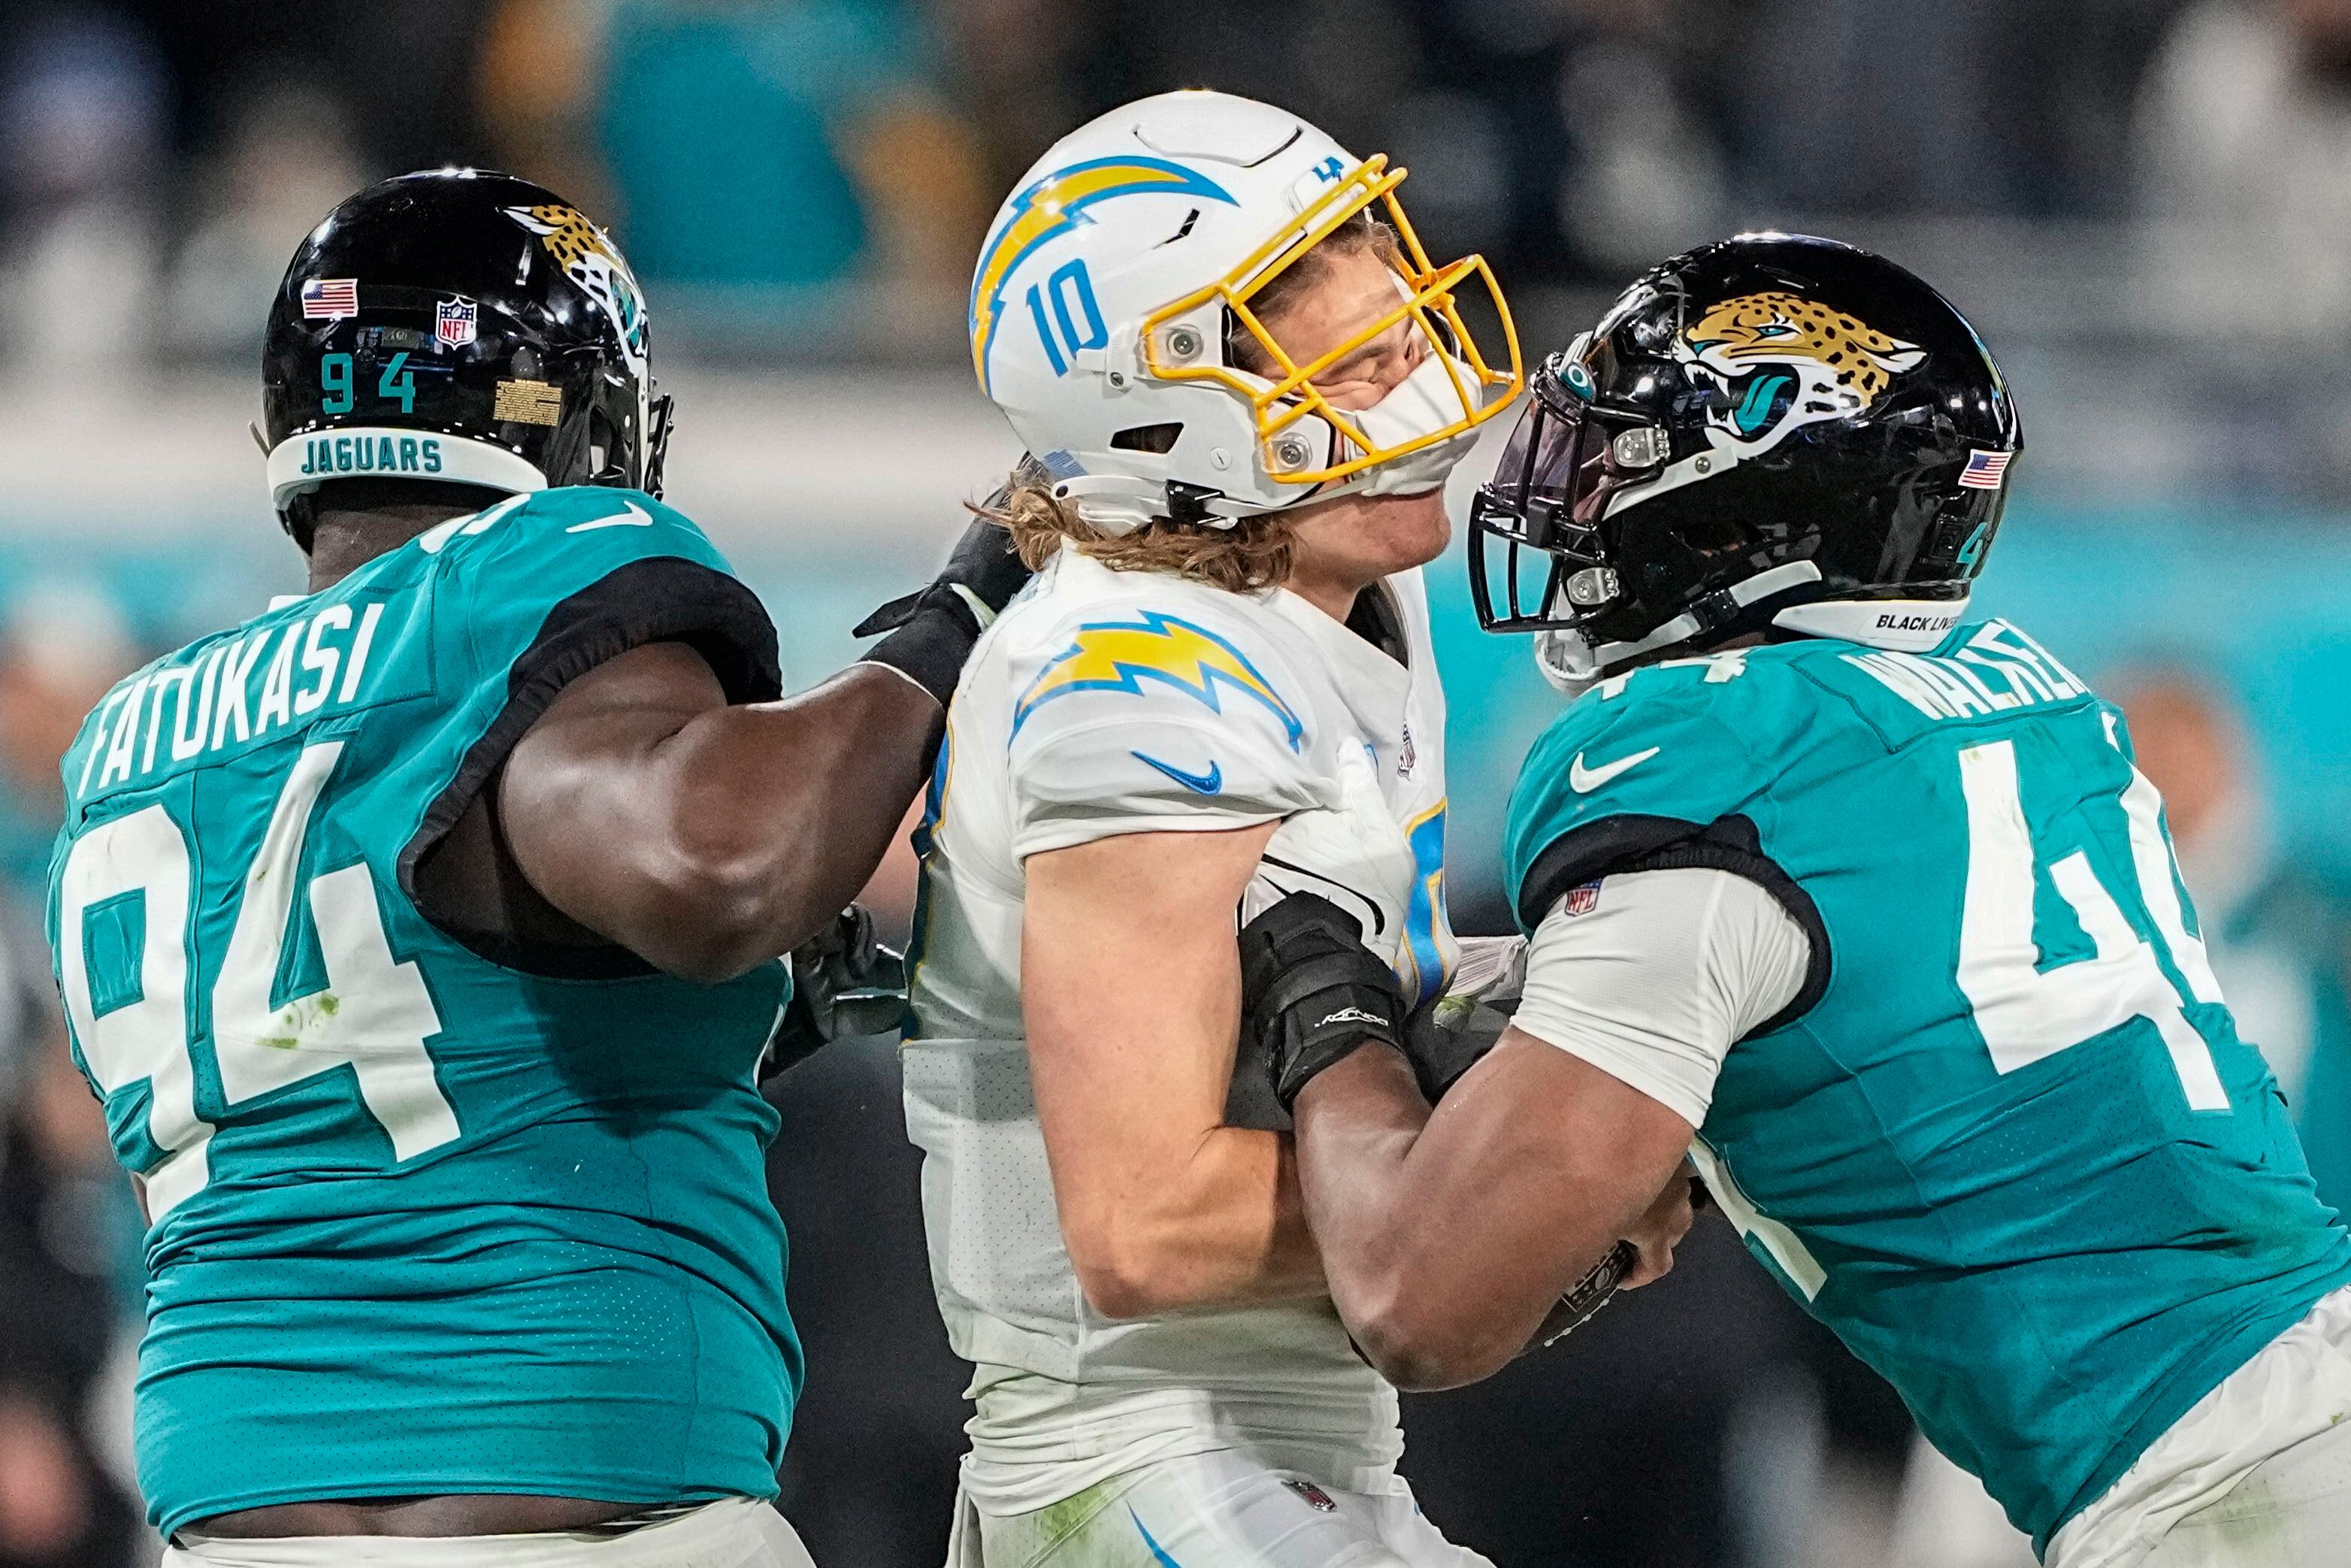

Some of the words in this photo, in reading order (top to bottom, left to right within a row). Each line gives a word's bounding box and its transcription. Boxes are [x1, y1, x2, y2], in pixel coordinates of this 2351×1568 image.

[1312, 156, 1344, 183] LA
[1025, 259, 1109, 377] 10
[322, 353, 415, 414] 94
[301, 437, 443, 475] JAGUARS
[1876, 615, 1932, 631] BLACK
[77, 602, 385, 800] FATUKASI
[1838, 617, 2092, 720] WALKE
[1568, 890, 1594, 913] NFL
[1957, 711, 2231, 1115] 44
[61, 740, 461, 1225] 94
